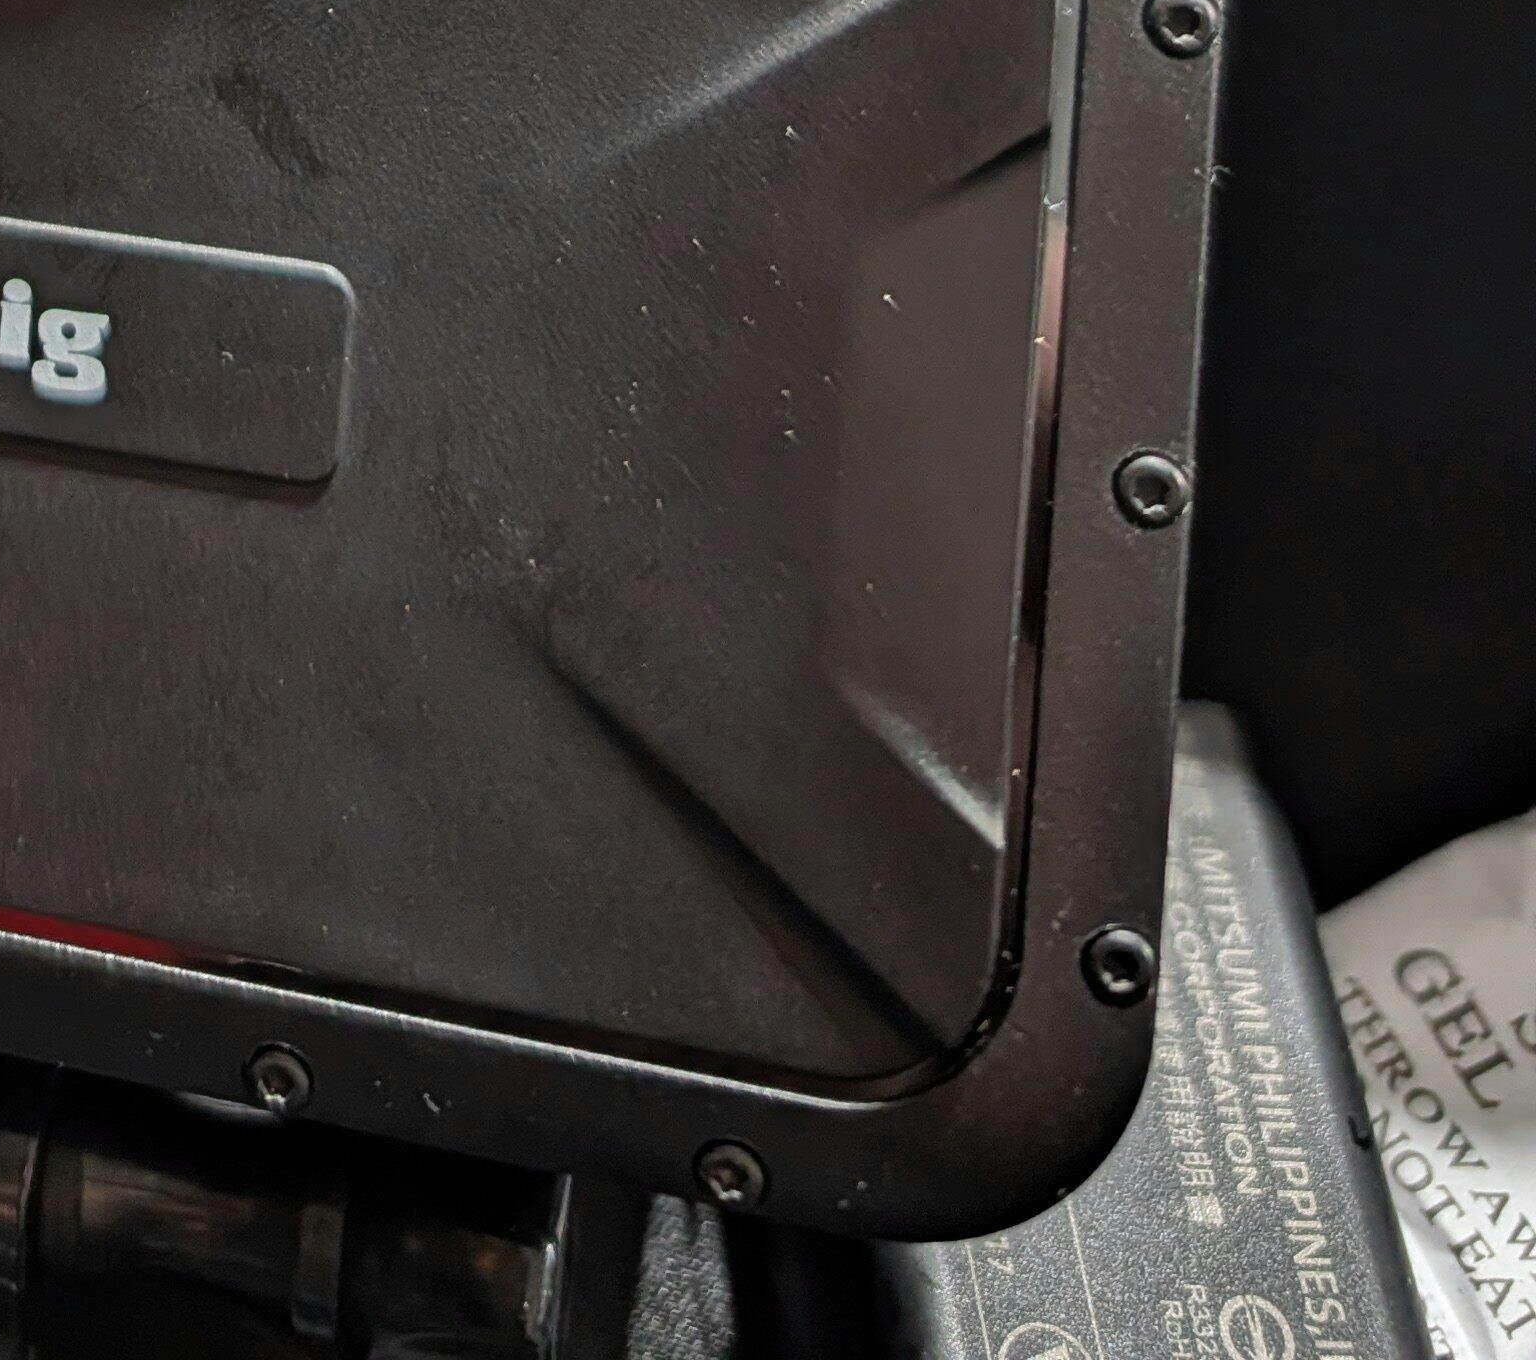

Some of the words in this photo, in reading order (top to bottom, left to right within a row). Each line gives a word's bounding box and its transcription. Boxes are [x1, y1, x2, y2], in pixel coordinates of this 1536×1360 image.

[1169, 900, 1264, 1195] CORPORATION
[1339, 976, 1489, 1170] THROW
[1468, 1188, 1536, 1282] AW
[1394, 947, 1514, 1110] GEL
[1182, 1283, 1221, 1360] R332
[1239, 1044, 1356, 1360] PHILIPPINES,I
[1368, 1106, 1466, 1227] NOT
[1447, 1228, 1536, 1341] EAT
